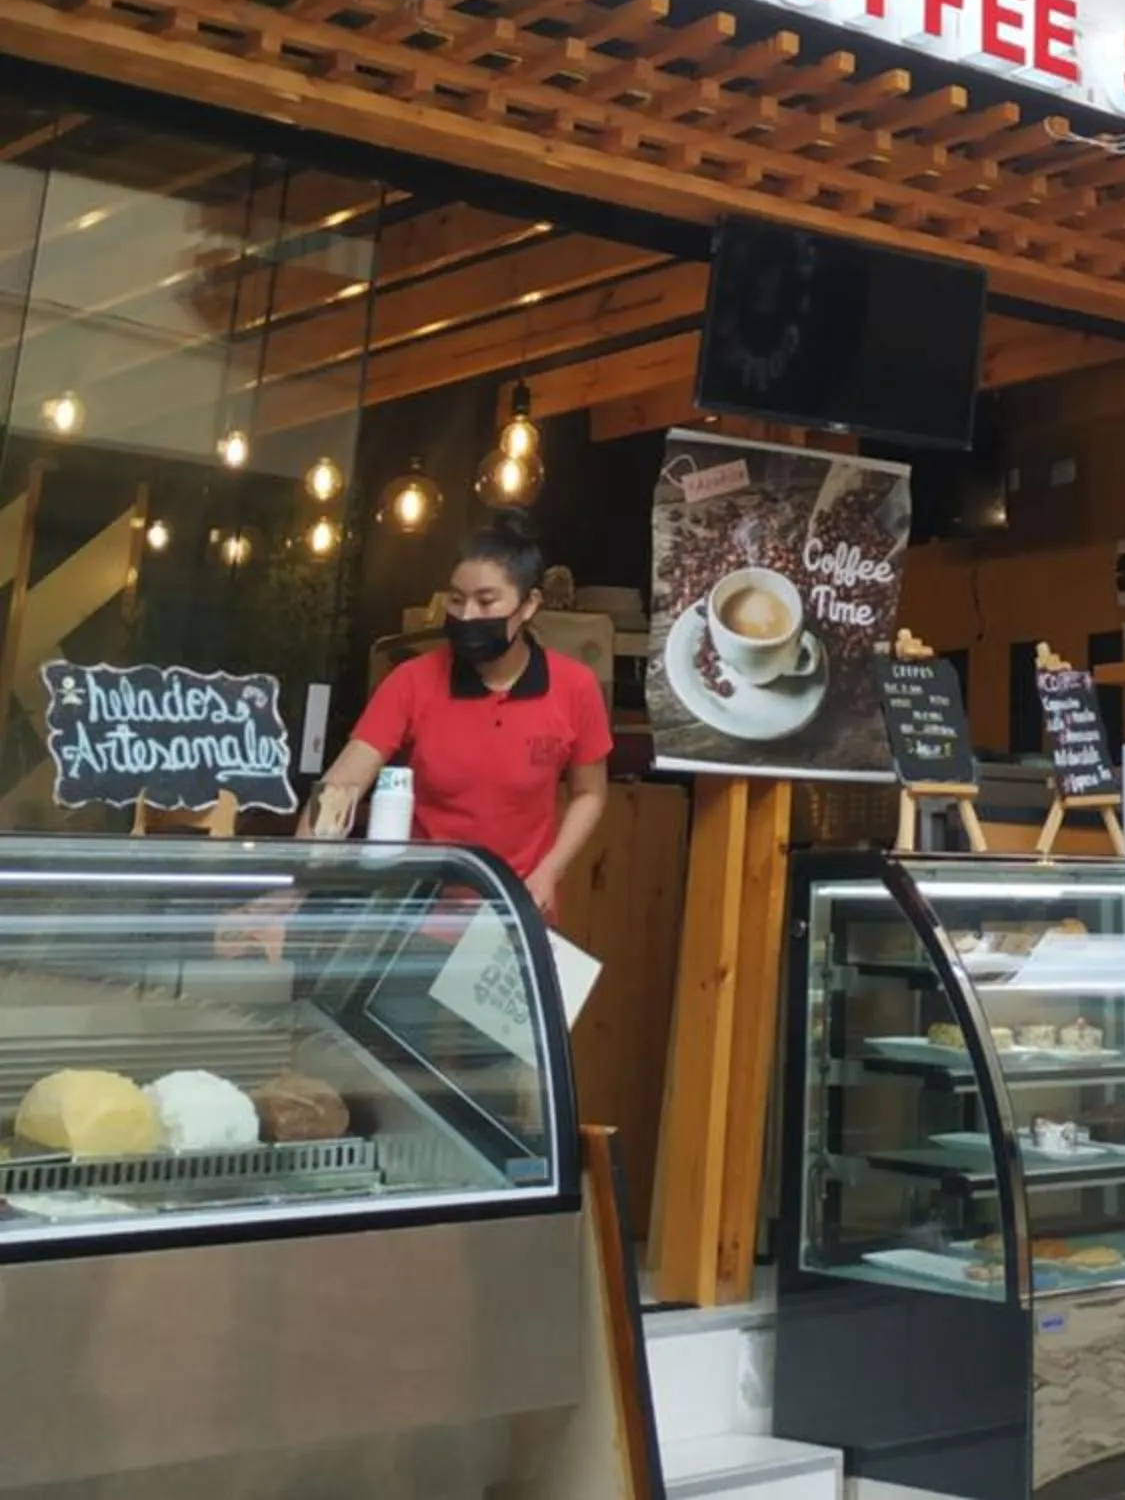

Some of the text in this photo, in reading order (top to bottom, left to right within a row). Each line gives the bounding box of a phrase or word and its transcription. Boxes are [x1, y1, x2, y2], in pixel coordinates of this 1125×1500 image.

[803, 539, 895, 586] Coffee
[811, 585, 876, 626] Time
[63, 719, 282, 780] Artesanales
